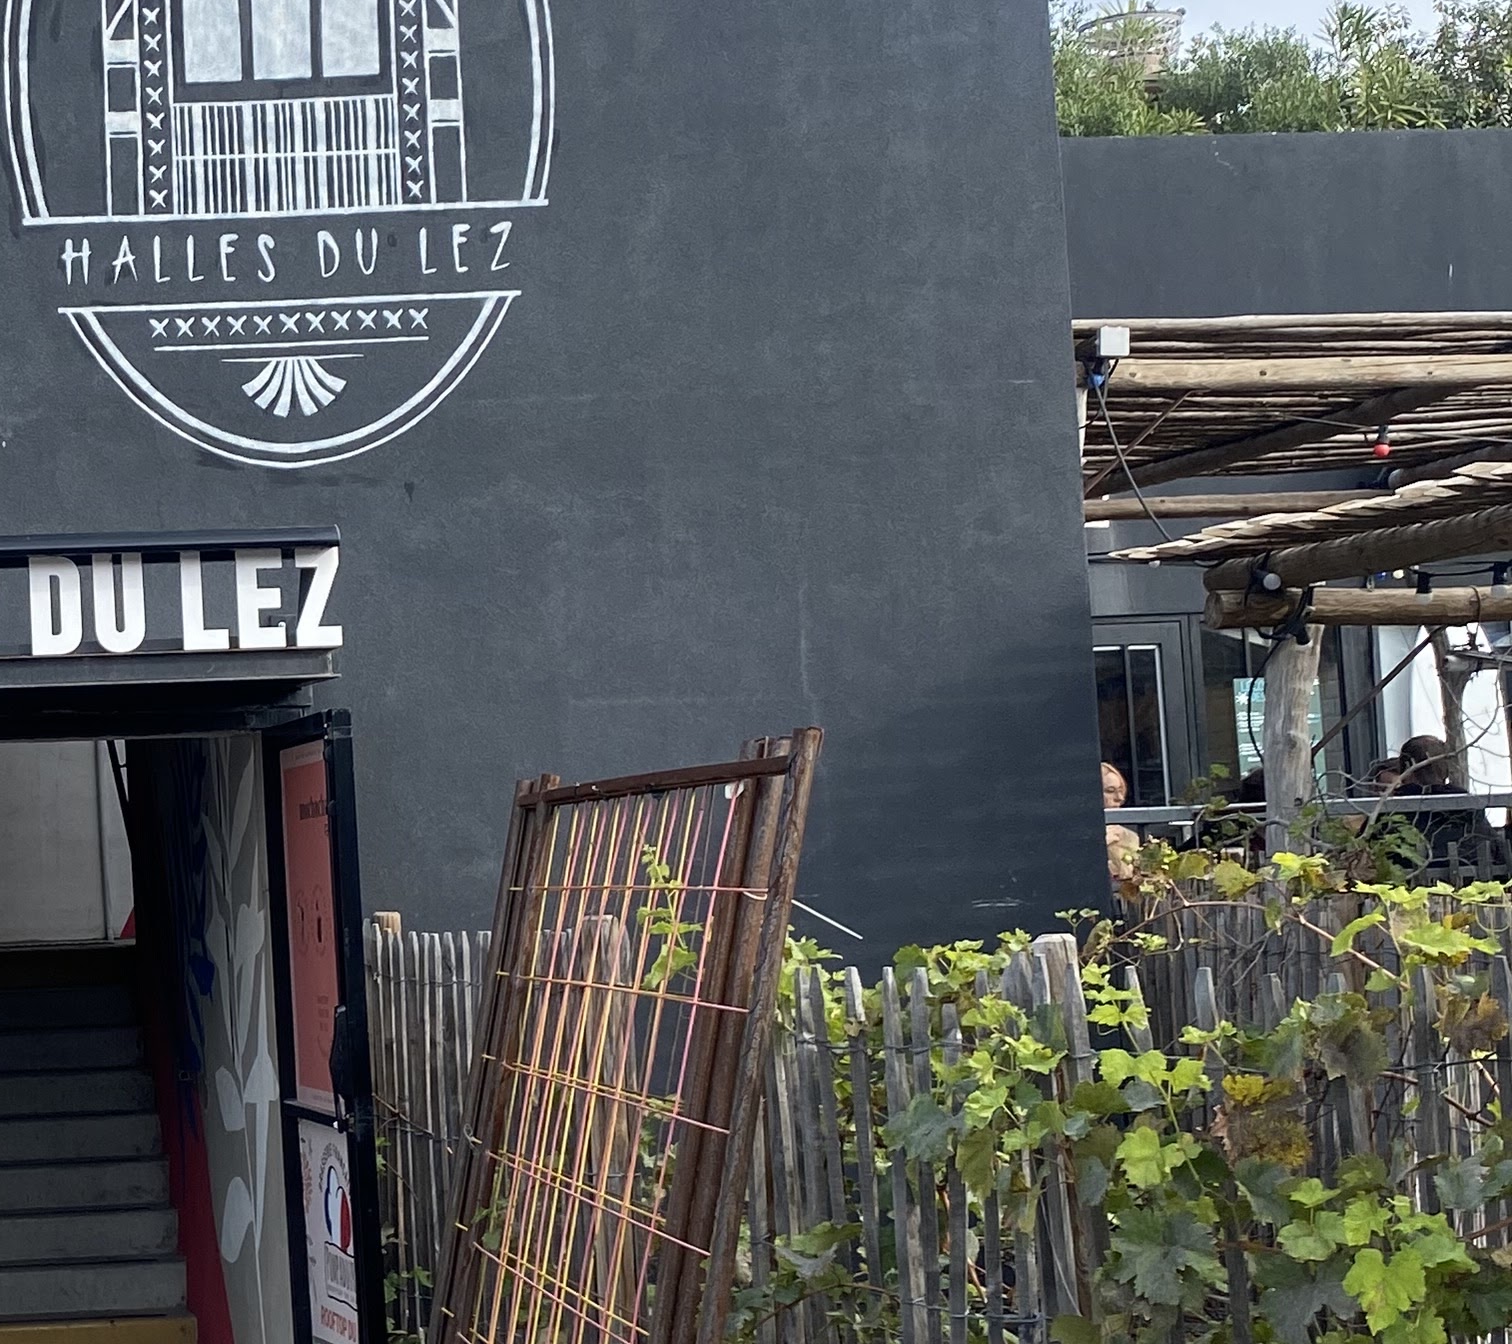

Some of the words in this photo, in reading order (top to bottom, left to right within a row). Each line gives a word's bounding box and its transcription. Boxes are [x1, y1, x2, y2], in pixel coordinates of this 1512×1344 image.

[62, 232, 275, 285] HALLES
[317, 228, 378, 277] DU
[419, 221, 512, 275] LEZ
[29, 551, 146, 656] DU
[180, 544, 343, 650] LEZ
